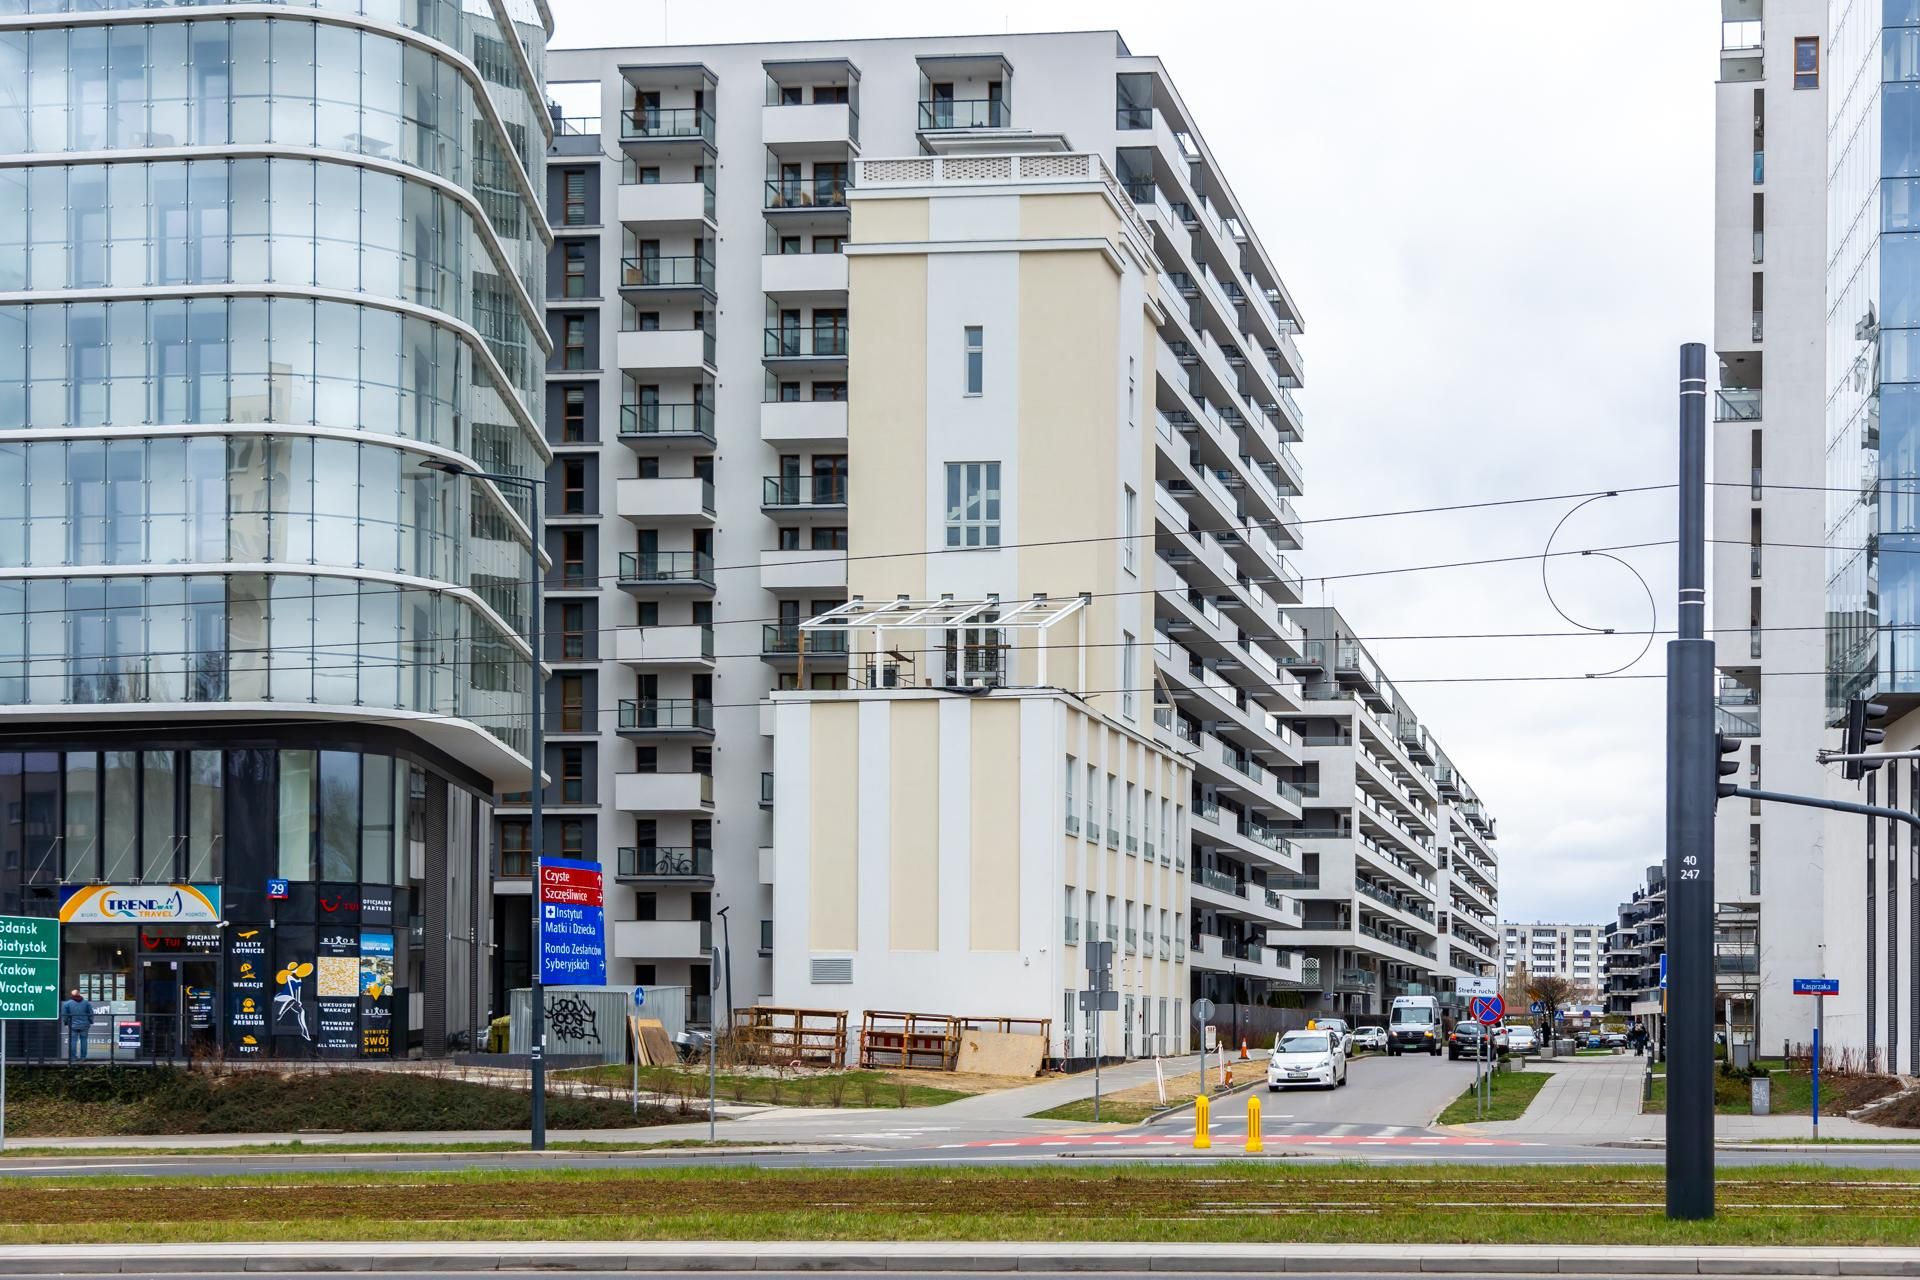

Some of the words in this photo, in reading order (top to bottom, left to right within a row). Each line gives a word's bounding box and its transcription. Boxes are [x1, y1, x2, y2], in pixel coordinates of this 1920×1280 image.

[1683, 855, 1697, 866] 40
[545, 869, 570, 884] Czyste
[1680, 869, 1700, 880] 247
[271, 883, 285, 895] 29
[545, 887, 588, 903] Szczęśliwice
[107, 899, 159, 911] TREND
[556, 906, 583, 922] Instytut
[545, 921, 567, 933] Matki
[569, 922, 572, 933] i
[573, 923, 596, 936] Dziecka
[164, 938, 181, 947] TUI
[545, 943, 570, 954] Rondo
[545, 957, 589, 972] Syberyjskich
[1478, 987, 1496, 995] ruchu
[1801, 983, 1831, 992] Kasprzaka
[363, 1035, 389, 1046] SWÓJ
